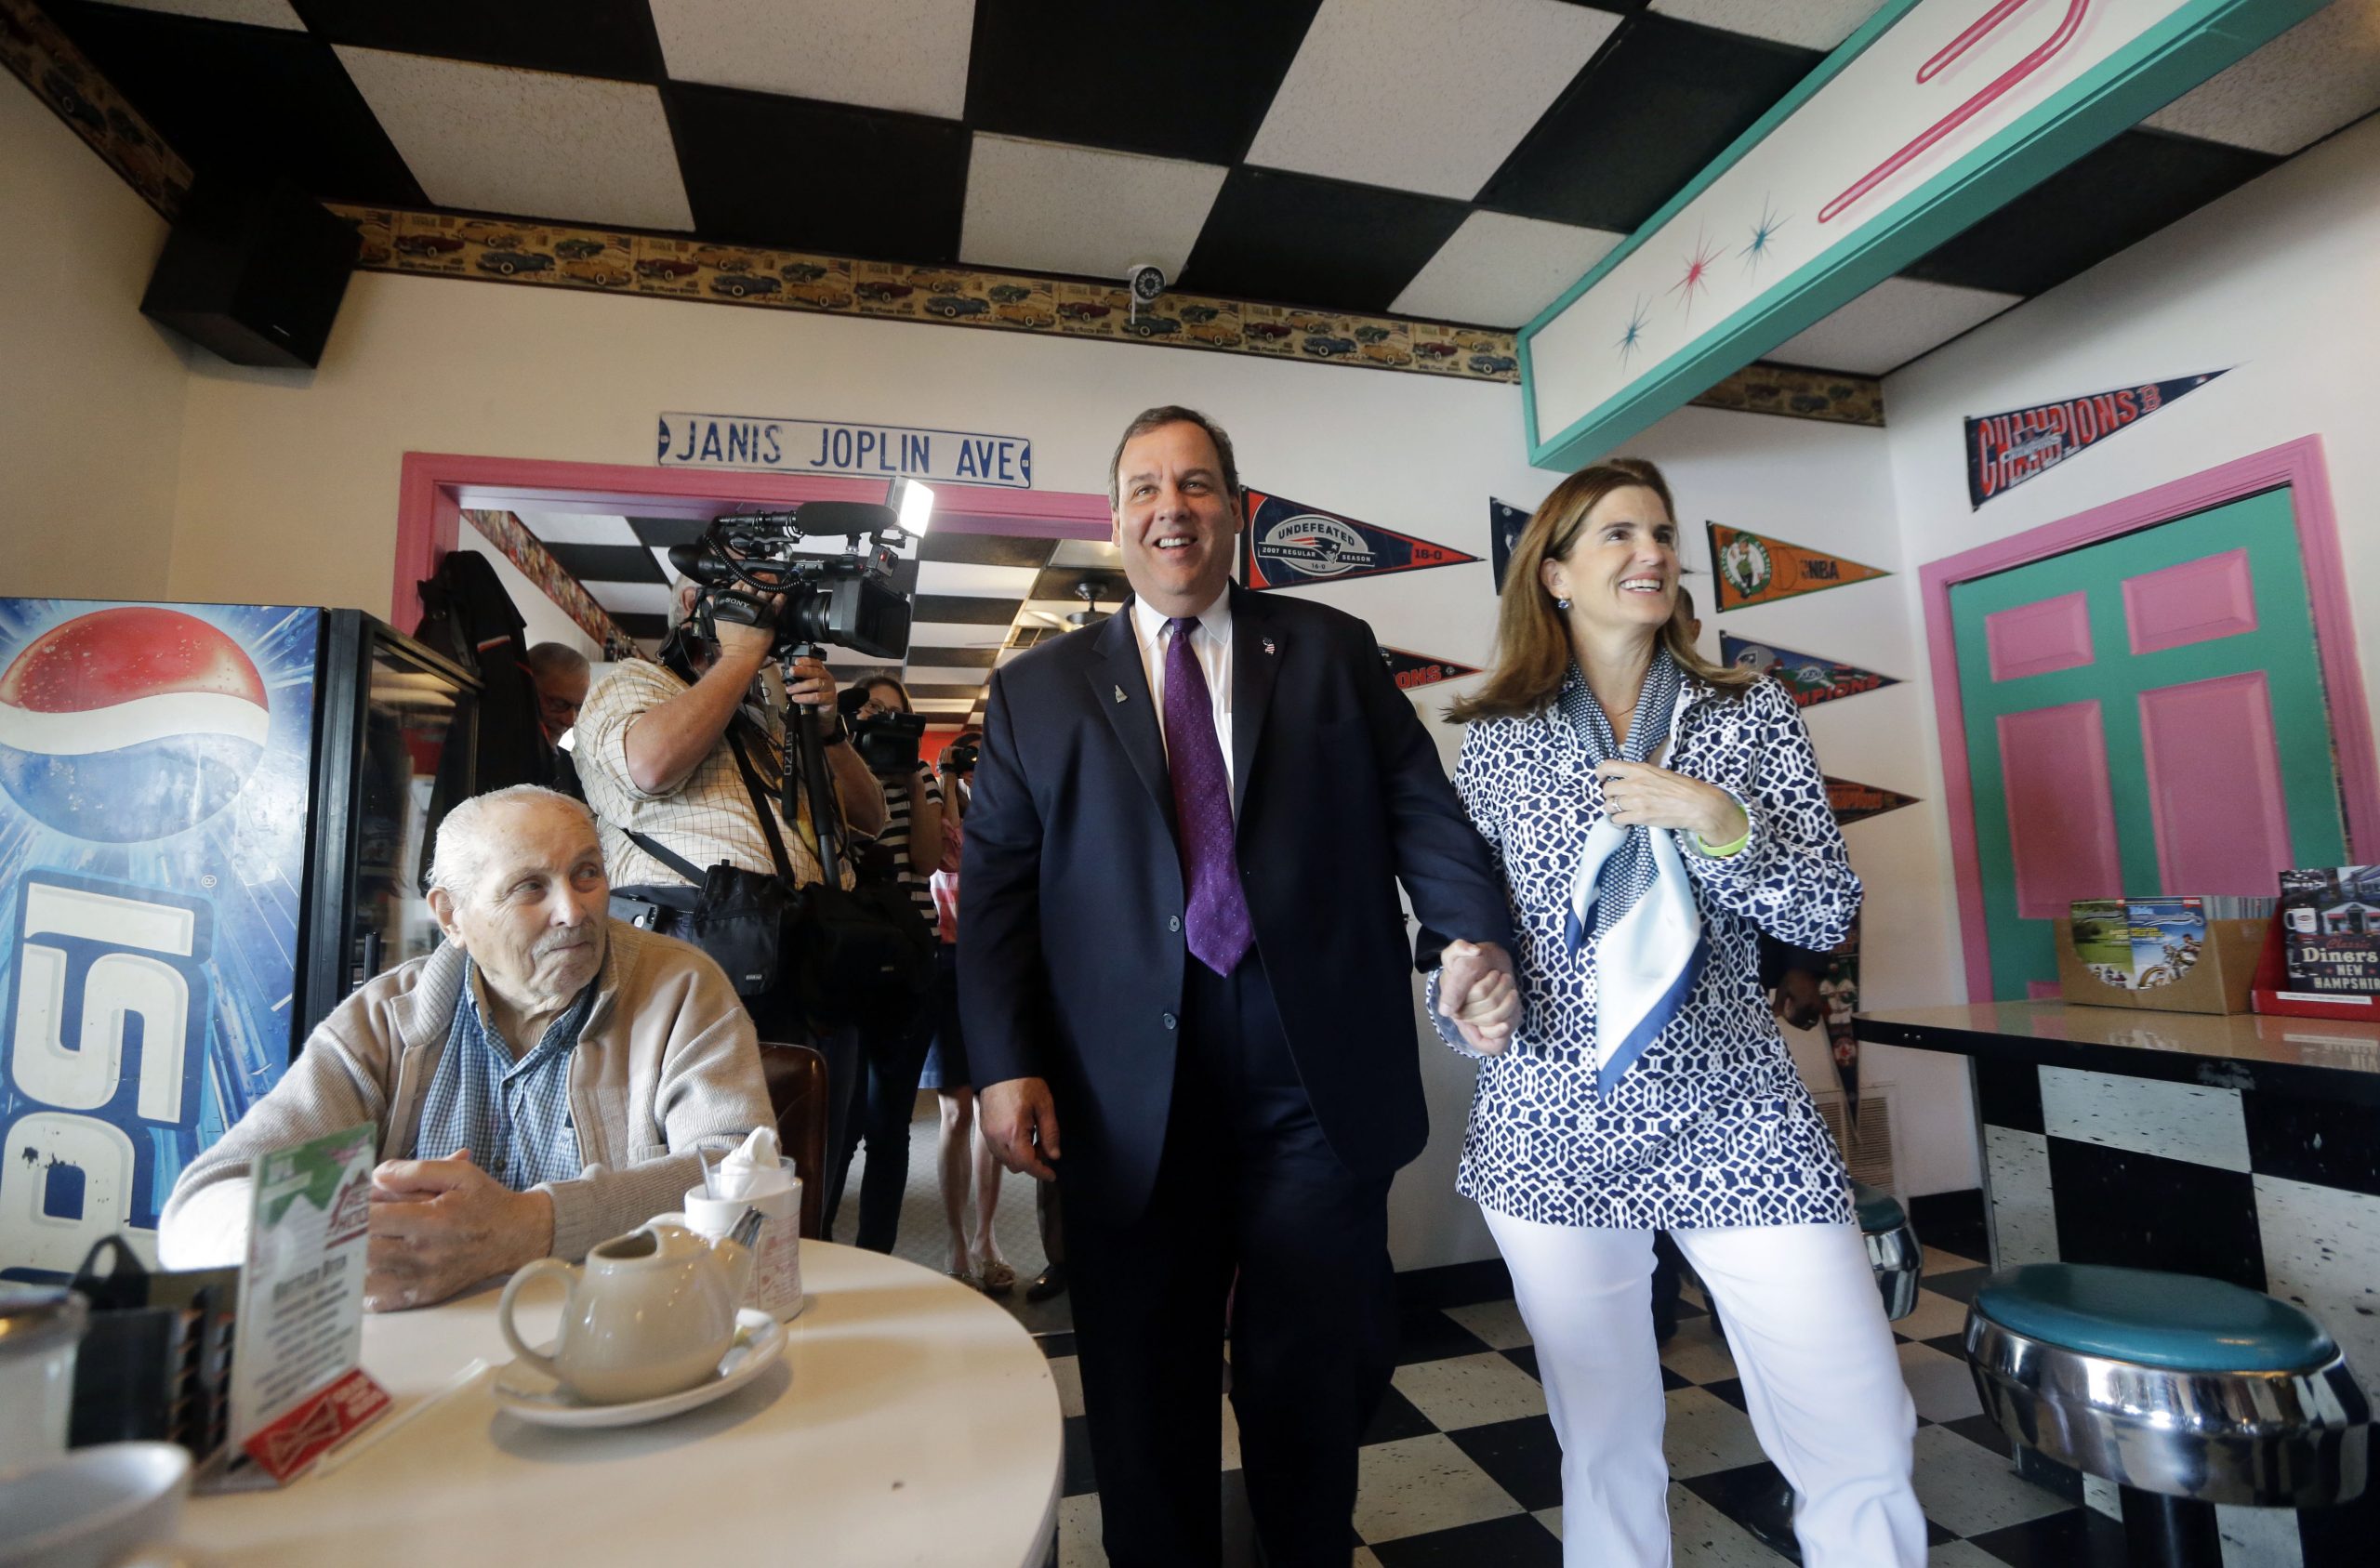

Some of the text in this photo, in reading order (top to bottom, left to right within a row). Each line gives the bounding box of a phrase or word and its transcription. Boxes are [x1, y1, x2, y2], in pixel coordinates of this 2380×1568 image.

[677, 420, 1015, 481] JANIS JOPLIN AVE
[1278, 522, 1355, 547] UNDEFEATED
[1262, 547, 1371, 562] 2007 REGULAR SEASON
[1807, 560, 1840, 580] NBA
[724, 597, 750, 609] SONY
[784, 731, 793, 776] GITZO
[2302, 947, 2379, 963] Diners
[2336, 965, 2363, 976] NEW
[2314, 978, 2380, 990] HAMPSHIR
[0, 882, 195, 1276] PSI
